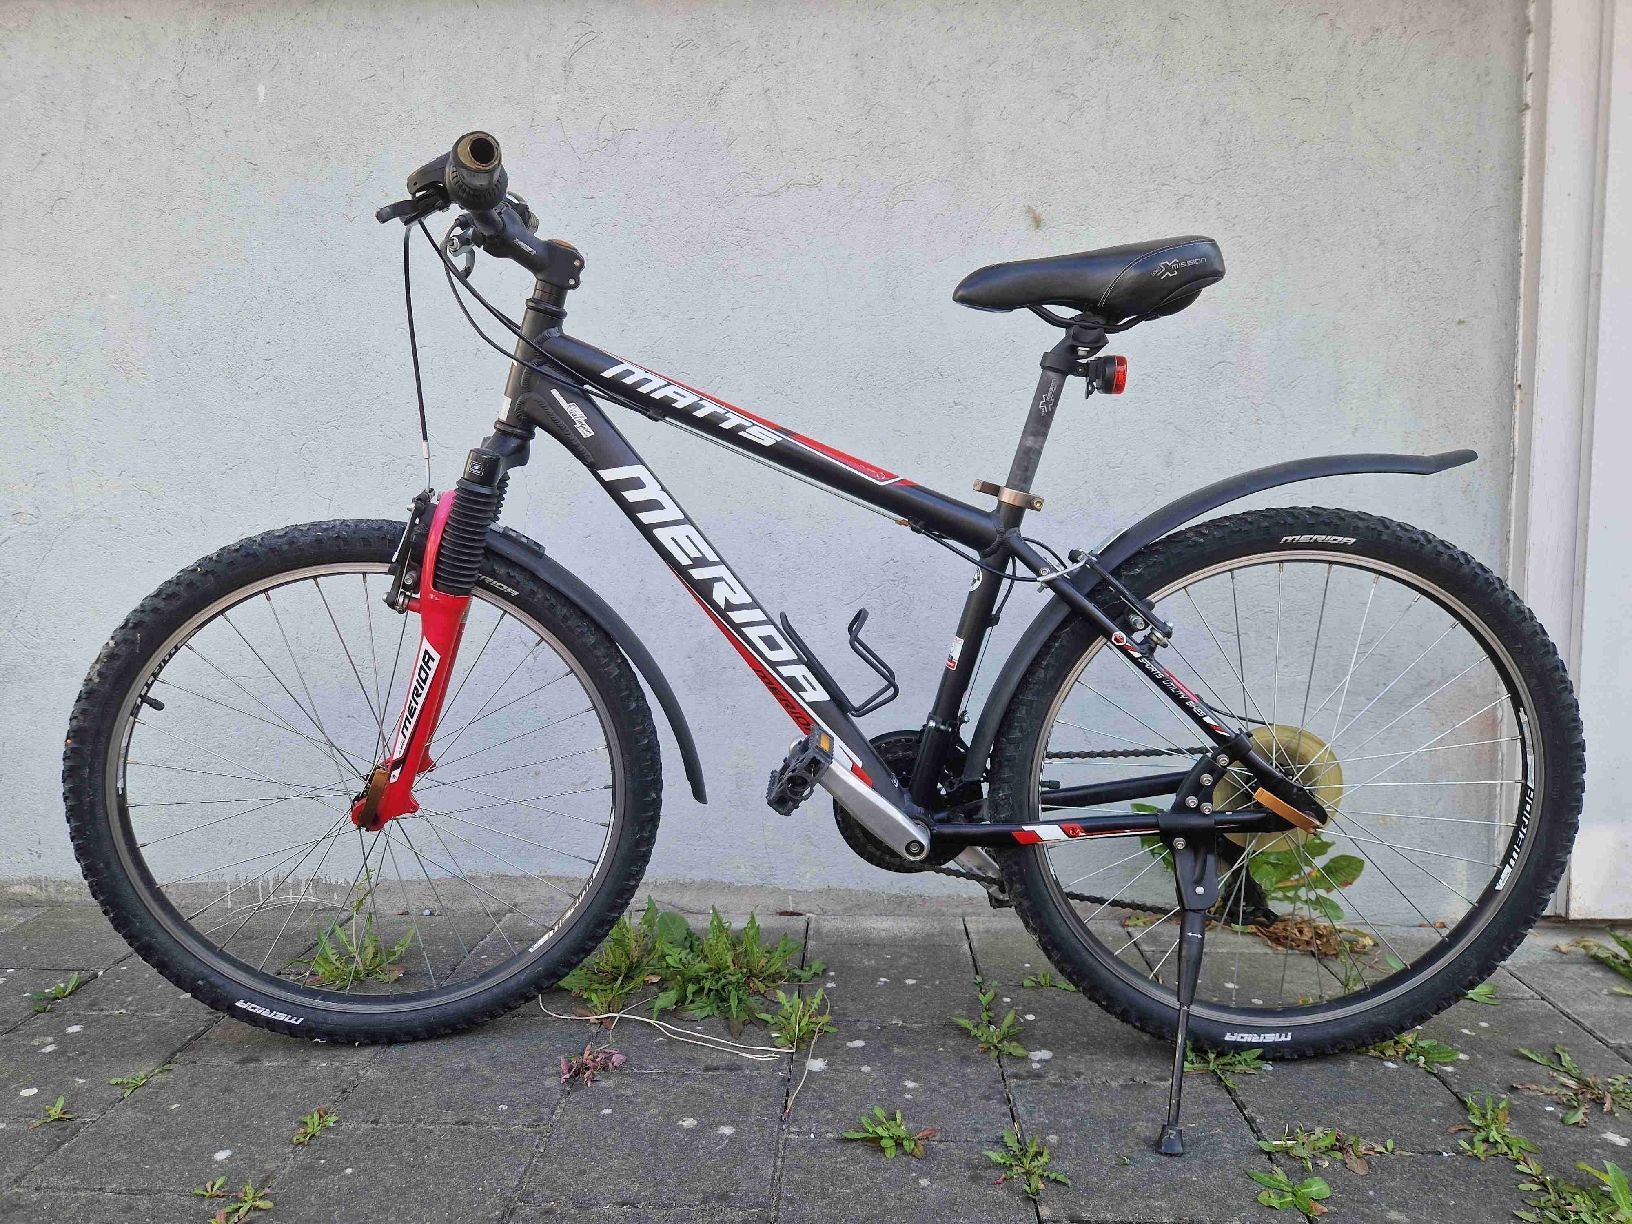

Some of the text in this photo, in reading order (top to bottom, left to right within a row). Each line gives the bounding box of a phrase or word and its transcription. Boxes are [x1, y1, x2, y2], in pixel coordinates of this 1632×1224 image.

[600, 362, 783, 447] MATTS
[1279, 534, 1357, 546] MERIDA
[598, 464, 831, 703] MERIDA
[401, 648, 436, 740] MERIDA
[234, 999, 305, 1026] MERIDA
[1223, 1031, 1293, 1044] MERIDA
